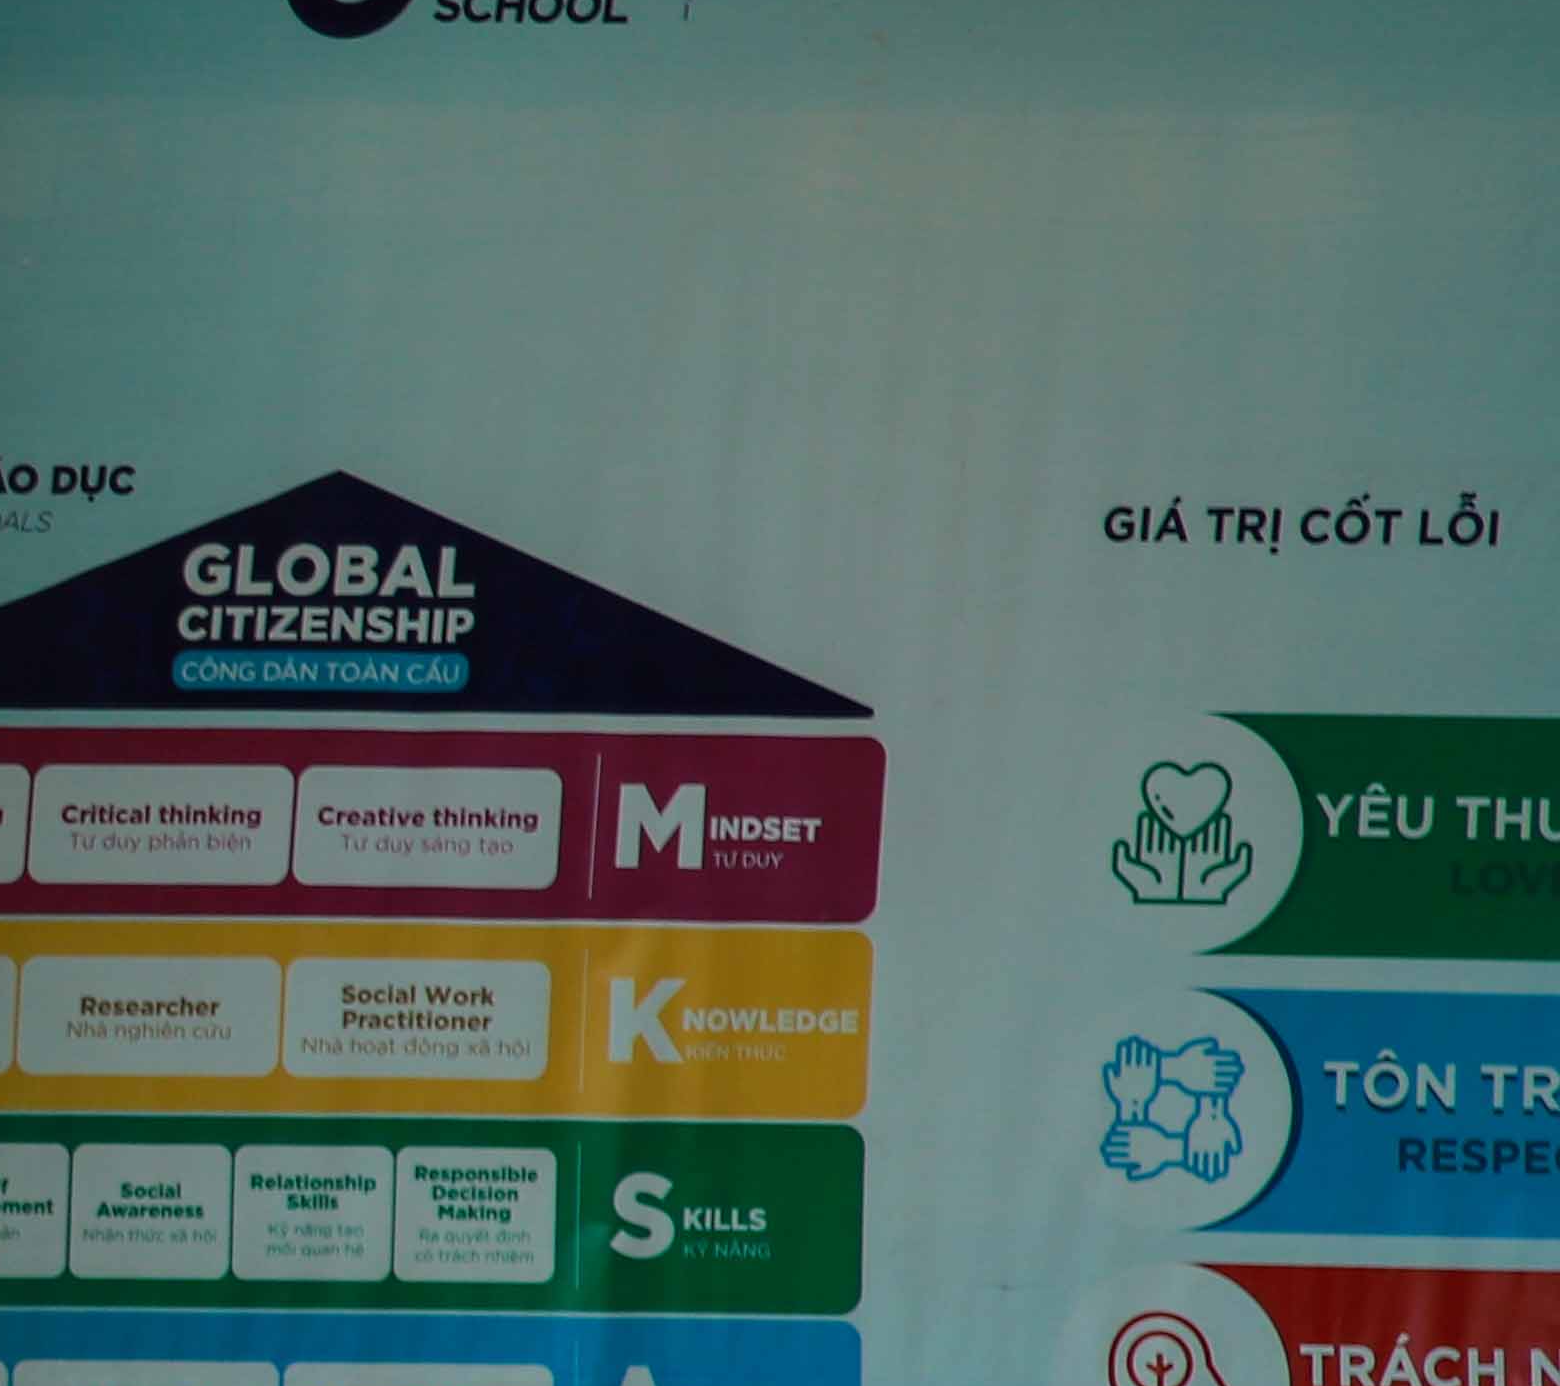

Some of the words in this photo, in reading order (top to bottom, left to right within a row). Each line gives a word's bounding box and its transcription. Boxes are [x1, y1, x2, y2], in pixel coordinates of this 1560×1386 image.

[48, 462, 137, 505] DỤC
[1100, 494, 1189, 545] GIÁ
[1203, 505, 1284, 557] TRỊ
[1297, 490, 1405, 548] CỐT
[1414, 489, 1501, 550] LỖI
[180, 541, 477, 600] GLOBAL
[175, 603, 476, 646] CITIZENSHIP
[60, 803, 150, 826] Critical
[160, 803, 262, 828] thinking
[318, 805, 425, 830] Creative
[433, 806, 539, 833] thinking
[1314, 780, 1434, 841] YÊU
[744, 851, 785, 873] DUY
[78, 995, 221, 1018] Researcher
[341, 983, 417, 1006] Social
[425, 984, 496, 1007] Work
[341, 1009, 494, 1033] Practitioner
[1323, 1047, 1458, 1110] TÔN
[1396, 1136, 1560, 1176] RESPE
[249, 1172, 378, 1196] Relationship
[414, 1164, 539, 1186] Responsible
[119, 1181, 182, 1200] Social
[286, 1193, 340, 1212] Skills
[431, 1183, 520, 1203] Decision
[96, 1201, 205, 1221] Awareness
[436, 1203, 512, 1225] Making
